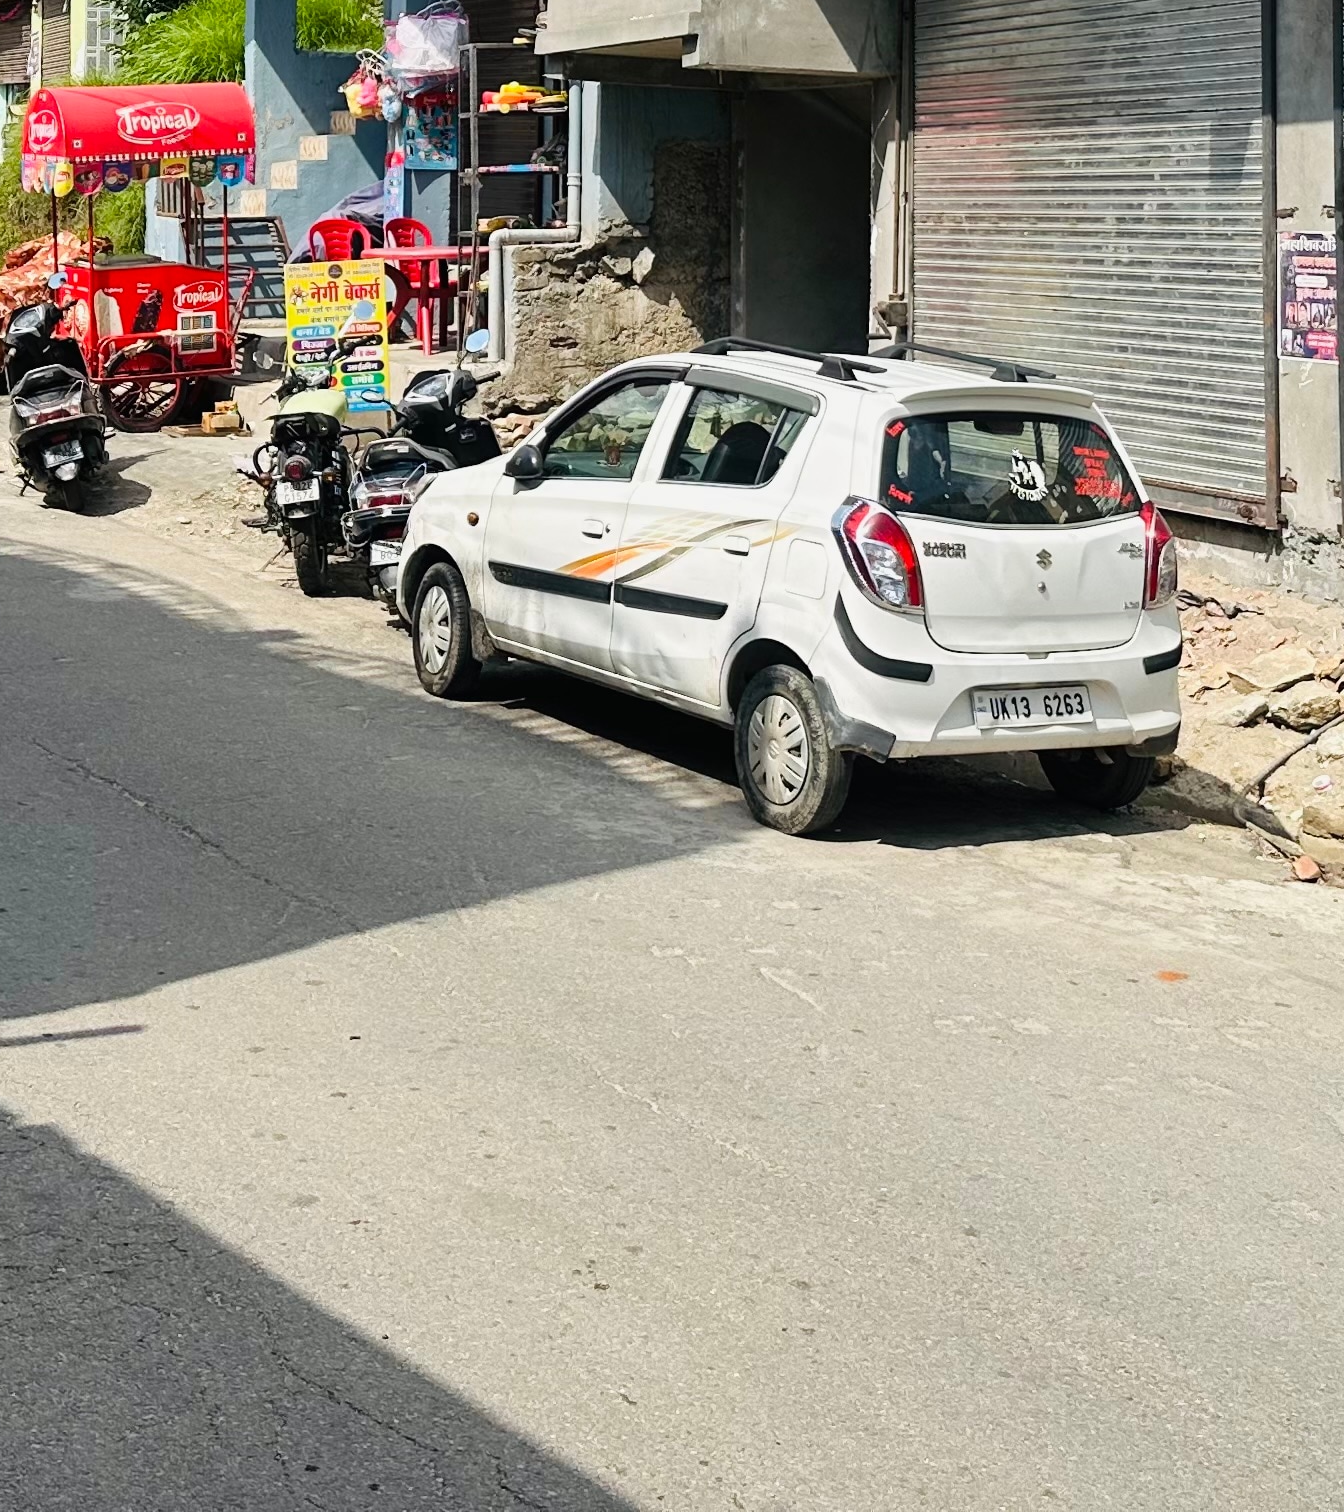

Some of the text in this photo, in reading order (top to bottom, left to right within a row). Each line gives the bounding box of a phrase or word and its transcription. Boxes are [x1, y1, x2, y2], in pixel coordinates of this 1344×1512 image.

[116, 101, 194, 135] Tropical
[173, 283, 219, 307] Tropical
[310, 277, 380, 303] नेगी बेकर्स
[924, 548, 966, 559] SUZUKI
[990, 693, 1085, 720] UK13 6263
